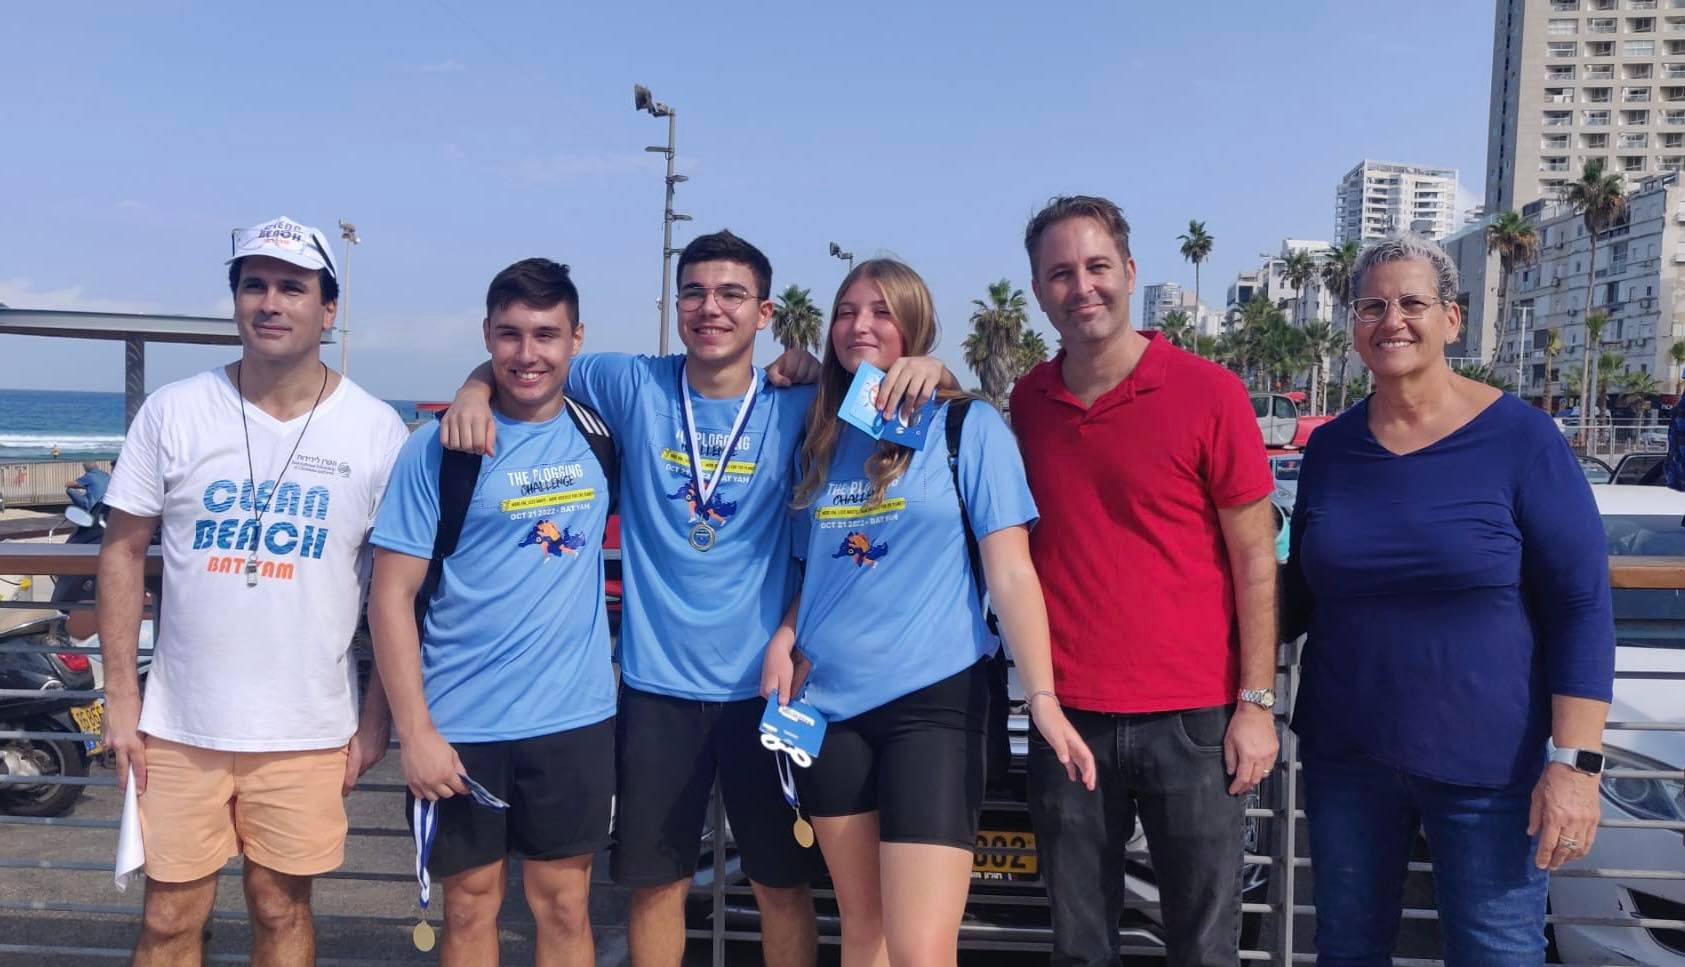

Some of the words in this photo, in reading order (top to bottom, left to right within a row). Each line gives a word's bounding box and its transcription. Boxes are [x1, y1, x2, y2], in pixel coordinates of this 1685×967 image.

[258, 229, 301, 241] BEACH
[695, 431, 751, 451] PLOGGNG
[507, 471, 530, 487] THE
[532, 463, 584, 482] PLOGGING
[733, 475, 750, 484] YAM
[520, 474, 576, 496] CHALLENGE
[826, 483, 847, 496] THE
[203, 478, 331, 520] CLEAN
[510, 510, 526, 521] OCT
[527, 510, 537, 518] 21
[560, 504, 575, 513] BAT
[576, 502, 592, 511] YAM
[820, 520, 836, 529] OCT
[192, 518, 329, 560] BEACH
[207, 556, 246, 575] BAT
